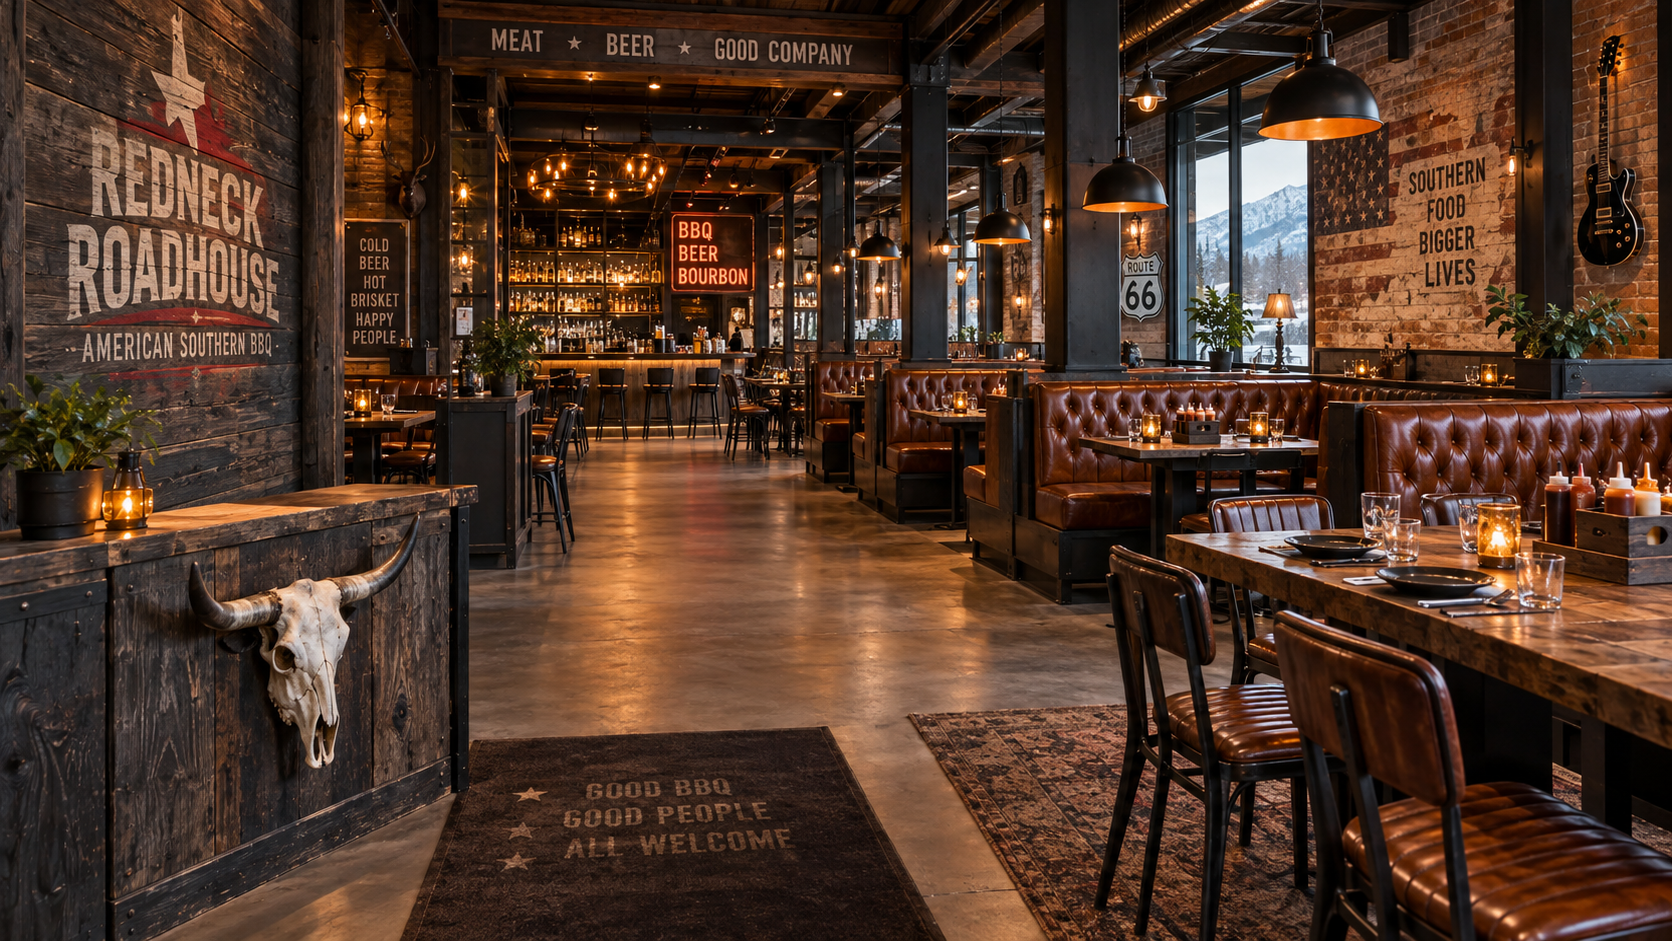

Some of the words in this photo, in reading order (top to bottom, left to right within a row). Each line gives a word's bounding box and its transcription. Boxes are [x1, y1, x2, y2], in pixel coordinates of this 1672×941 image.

[491, 28, 543, 52] MEAT
[606, 33, 655, 58] BEER
[714, 38, 759, 61] GOOD
[768, 41, 853, 66] COMPANY
[90, 126, 264, 249] REDNECK
[1408, 157, 1486, 195] SOUTHERN
[1427, 194, 1466, 223] FOOD
[679, 222, 711, 241] BBQ
[1419, 225, 1475, 255] BIGGER
[359, 238, 389, 252] COLD
[678, 245, 718, 262] BEER
[67, 224, 280, 323] ROADHOUSE
[359, 256, 389, 270] BEER
[1127, 261, 1154, 273] ROUTE
[1425, 258, 1476, 287] LIVES
[363, 275, 386, 289] HOT
[678, 267, 748, 285] BOURBON
[351, 293, 399, 307] BRISKET
[1125, 280, 1156, 310] 66
[356, 312, 394, 327] HAPPY
[82, 331, 173, 363] AMERICAN
[180, 333, 245, 357] SOUTHERN
[250, 334, 272, 357] BBQ
[353, 330, 396, 344] PEOPLE
[586, 780, 660, 800] GOOD
[675, 778, 732, 797] BBQ
[563, 807, 643, 829] GOOD
[657, 802, 771, 826] PEOPLE
[564, 836, 623, 859] ALL
[639, 829, 796, 856] WELCOME
